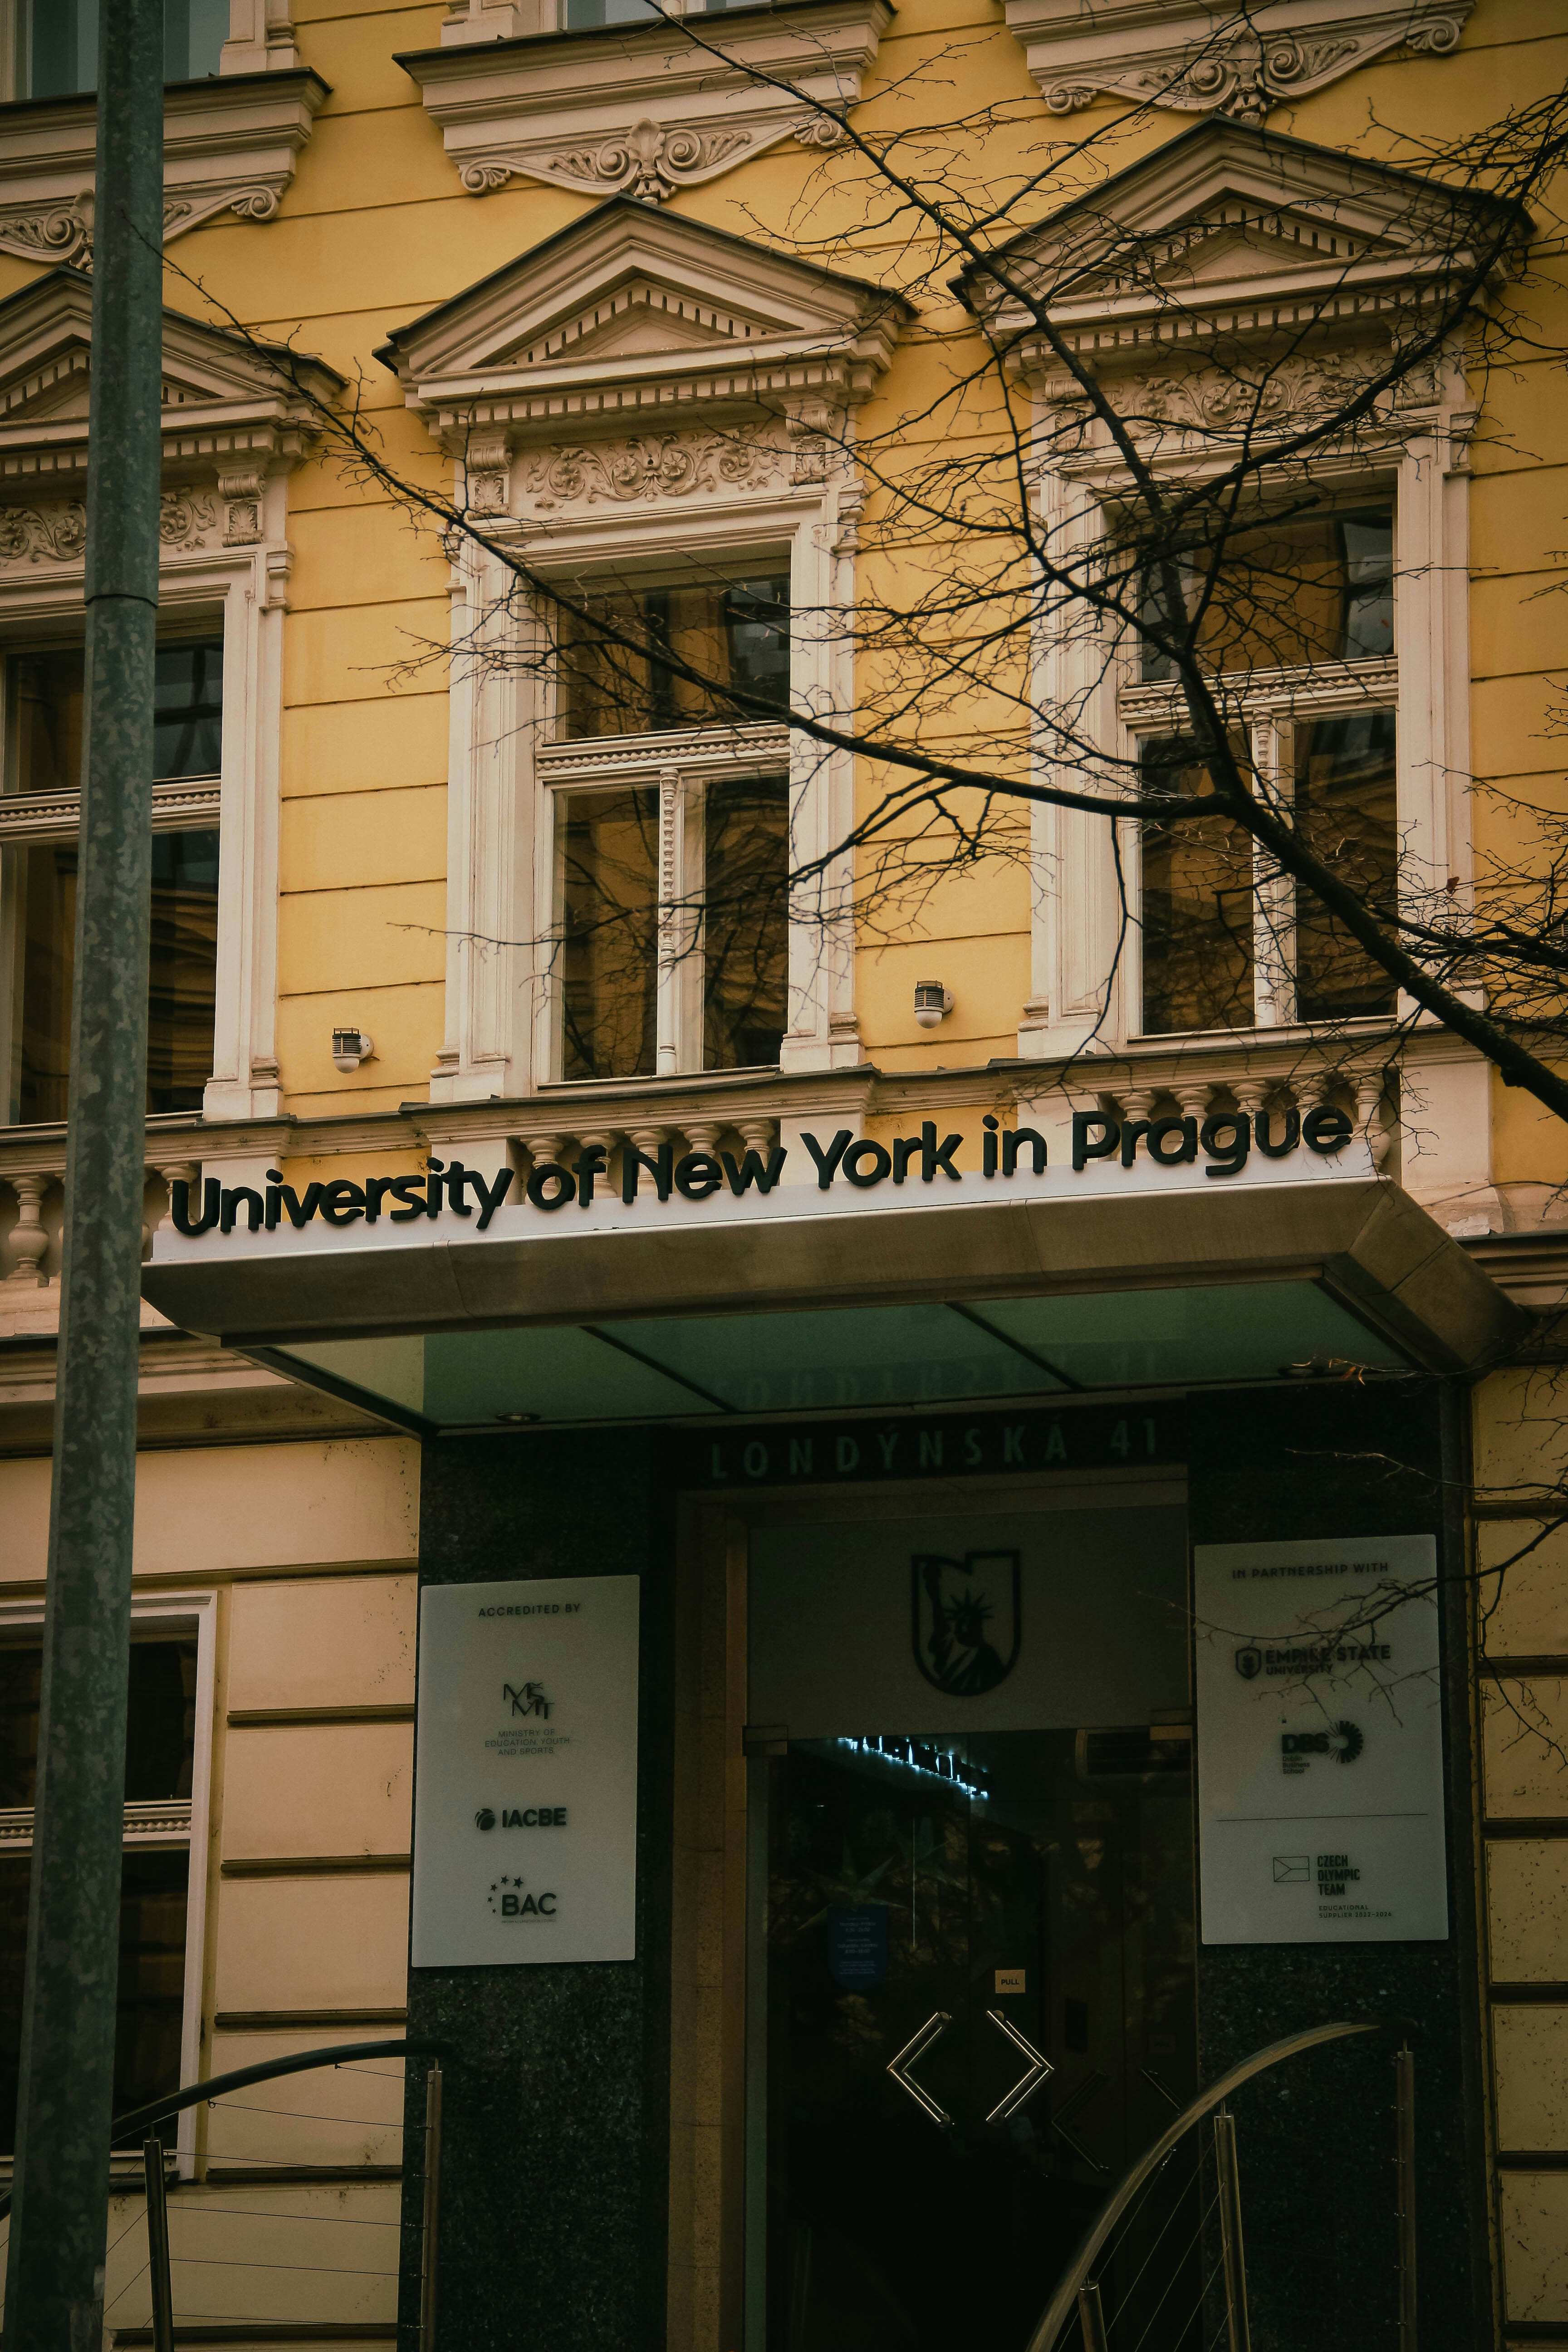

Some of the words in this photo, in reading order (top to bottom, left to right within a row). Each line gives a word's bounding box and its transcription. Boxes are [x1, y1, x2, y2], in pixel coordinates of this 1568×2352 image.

[172, 1157, 515, 1236] University
[527, 1144, 608, 1210] of
[622, 1143, 788, 1204] New
[799, 1120, 964, 1189] York
[982, 1114, 1048, 1178] in
[1072, 1105, 1353, 1176] Prague
[711, 1414, 1067, 1479] LONDÝNSKÁ
[1110, 1417, 1156, 1457] 41
[1233, 1570, 1245, 1579] IN
[1252, 1564, 1348, 1578] PARTNERSHIP
[1353, 1563, 1388, 1573] WITH
[478, 1604, 559, 1617] ACCREDITED
[565, 1604, 580, 1612] BY
[1265, 1647, 1331, 1664] EMPIRE
[1337, 1645, 1391, 1661] STATE
[1266, 1664, 1333, 1675] UNIVERSITY
[1282, 1733, 1329, 1754] DBS
[502, 1808, 567, 1828] IACBE
[1318, 1855, 1348, 1867] CZECH
[1318, 1869, 1360, 1881] OLYMPIC
[1318, 1883, 1345, 1895] TEAM
[502, 1893, 557, 1916] BAC
